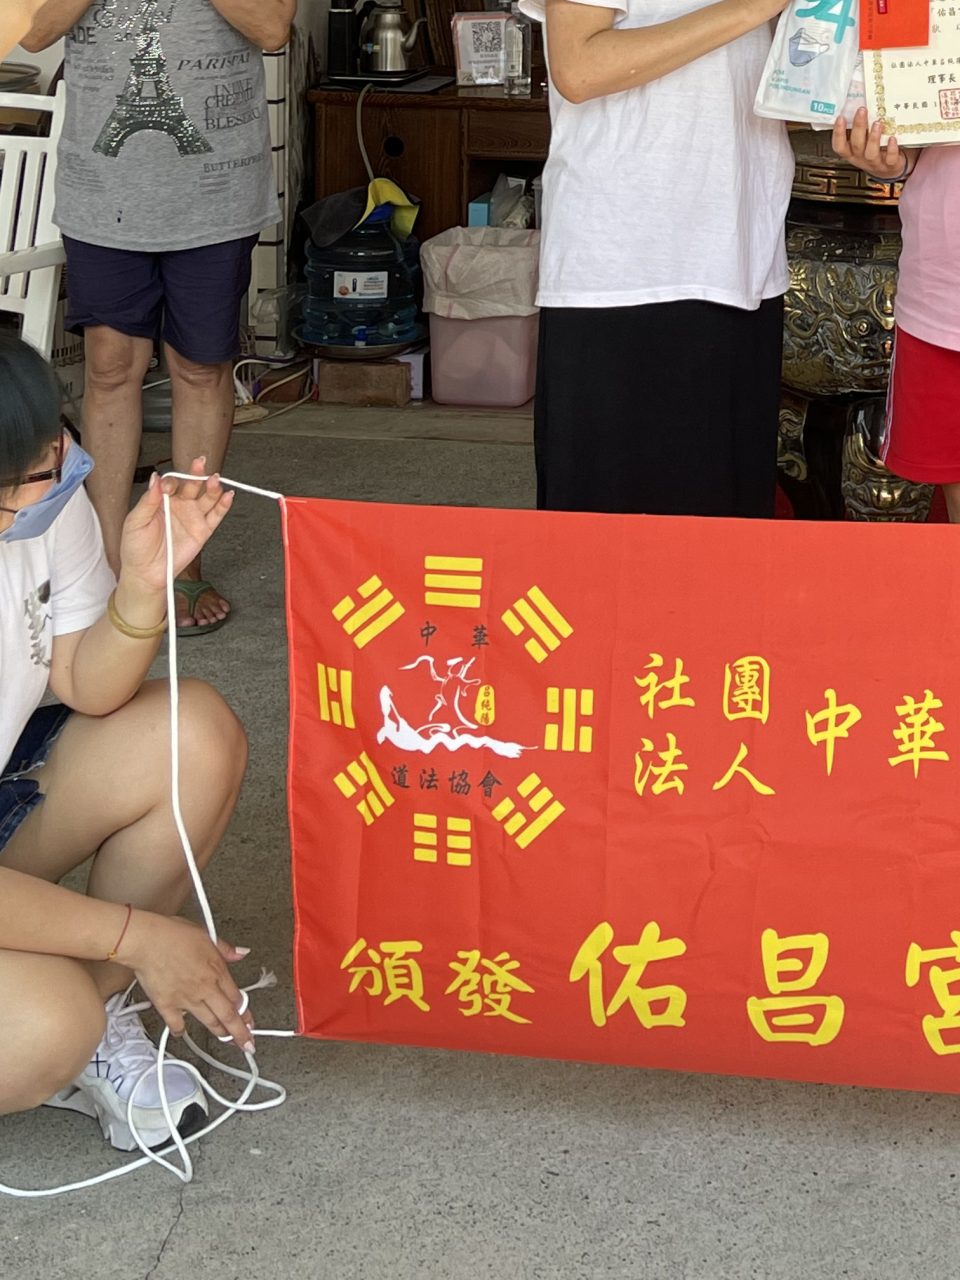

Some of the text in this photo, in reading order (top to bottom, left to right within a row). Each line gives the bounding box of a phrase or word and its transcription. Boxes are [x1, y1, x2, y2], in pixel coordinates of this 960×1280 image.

[419, 620, 490, 649] 中華
[480, 686, 492, 725] 呂純陽
[634, 652, 771, 725] 社團
[390, 764, 503, 798] 道法協會
[632, 732, 776, 798] 法人
[340, 938, 534, 1024] 頒發
